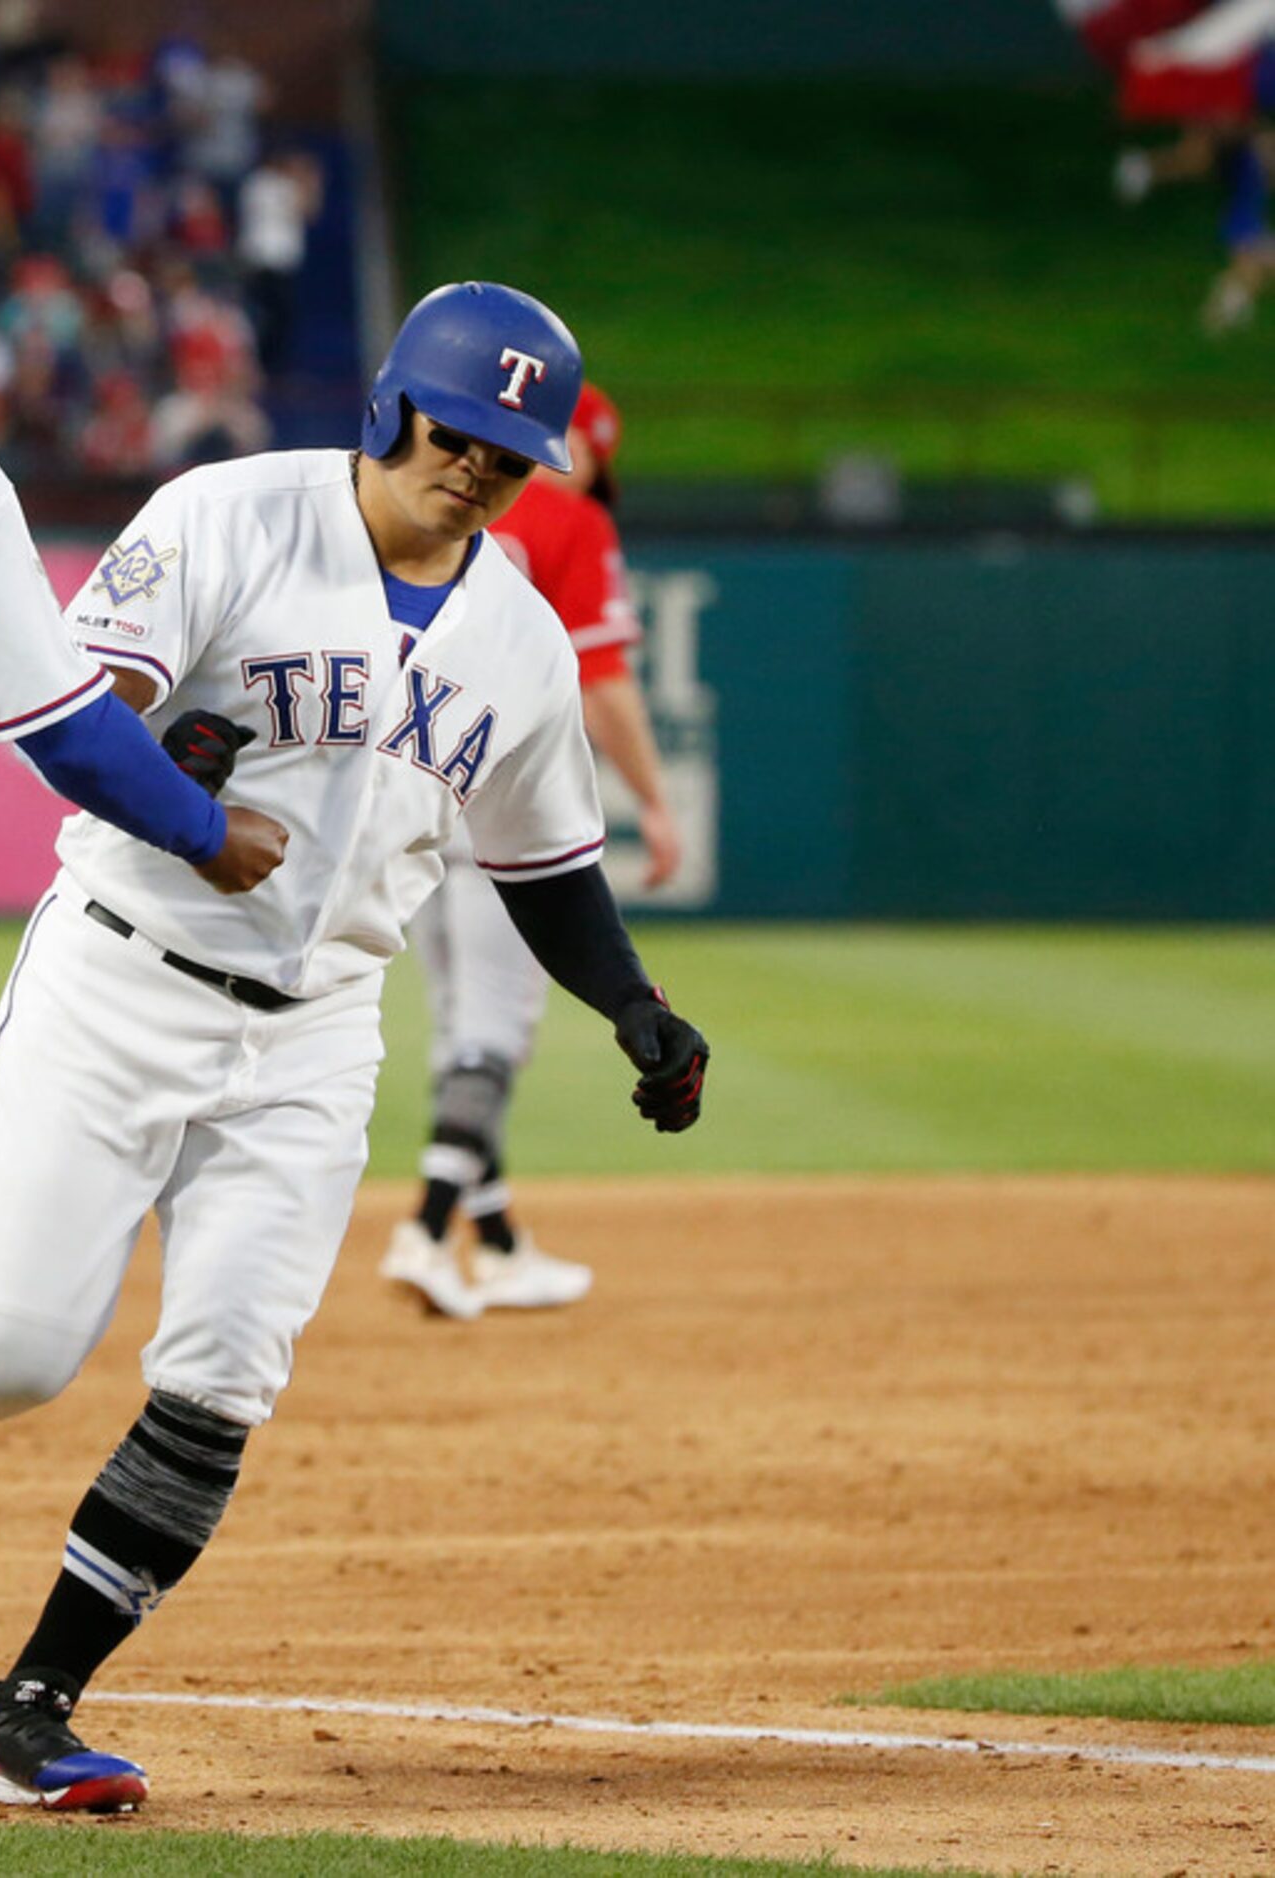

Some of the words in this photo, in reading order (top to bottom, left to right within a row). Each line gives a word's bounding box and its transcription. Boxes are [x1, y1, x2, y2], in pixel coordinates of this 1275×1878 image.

[498, 347, 548, 411] T
[116, 555, 149, 584] 42
[241, 650, 498, 806] TEXA
